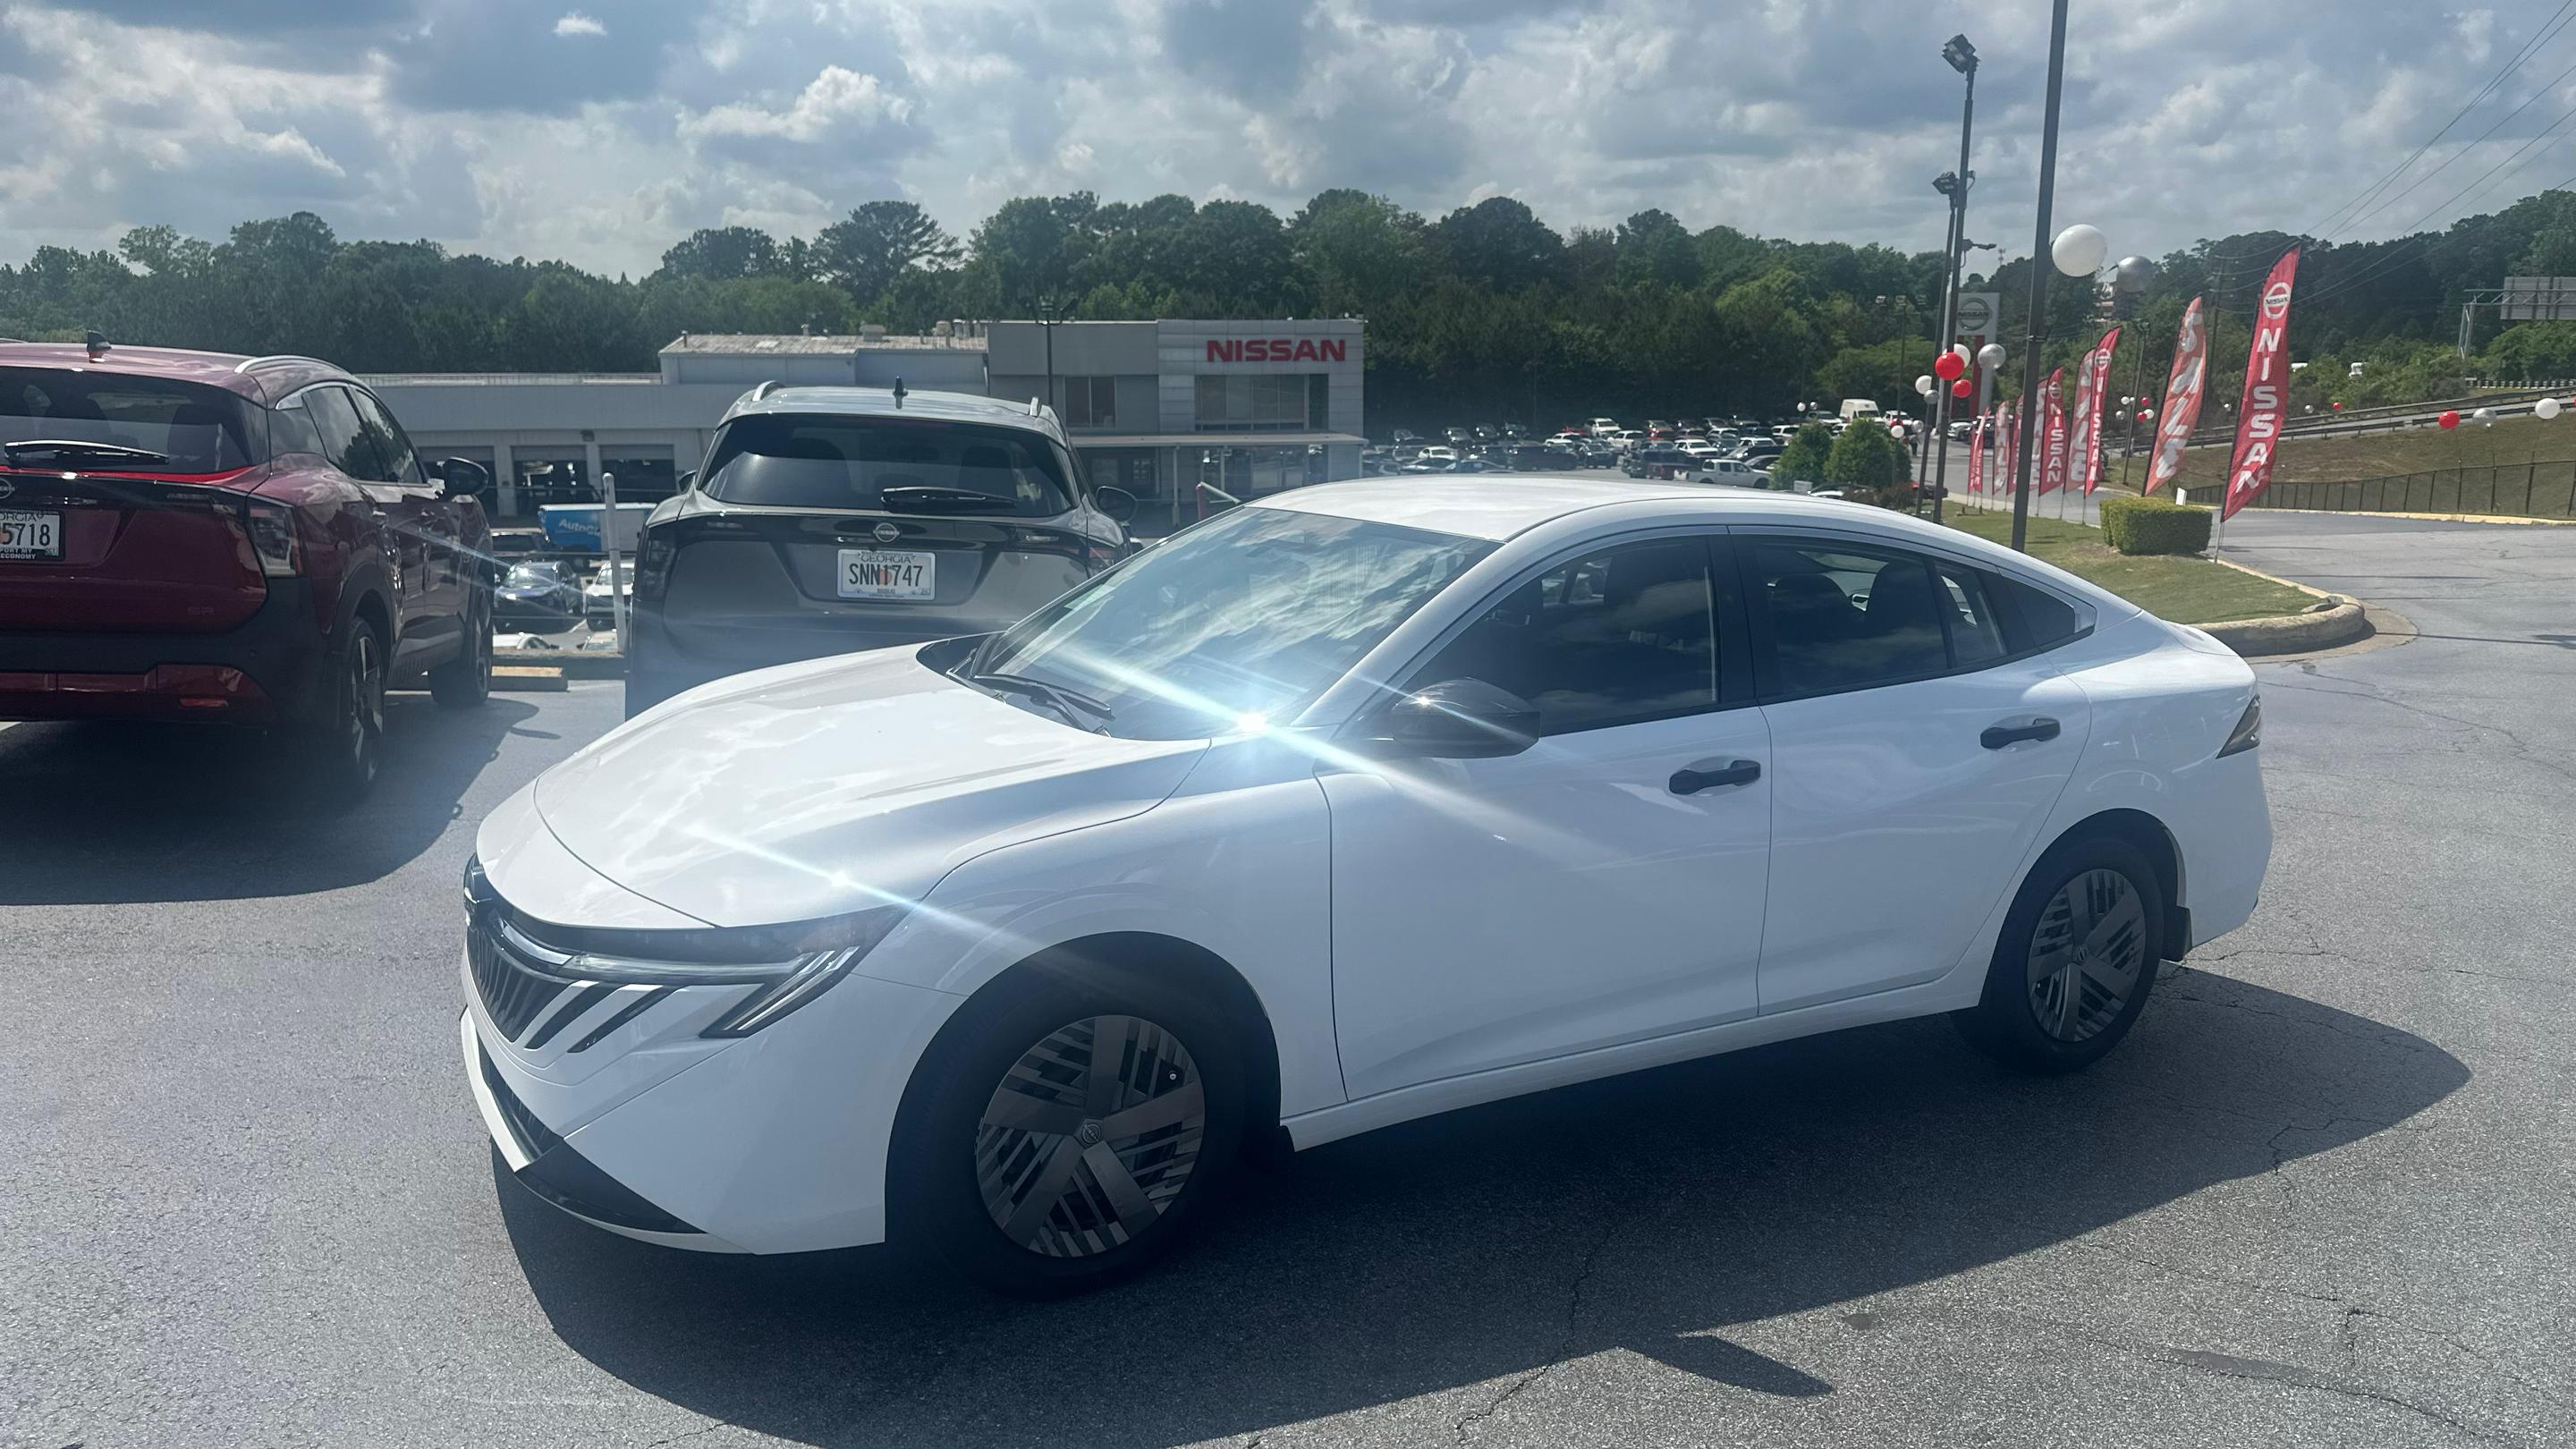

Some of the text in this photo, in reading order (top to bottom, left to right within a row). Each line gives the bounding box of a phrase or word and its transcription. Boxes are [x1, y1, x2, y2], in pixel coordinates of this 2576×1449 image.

[1207, 339, 1345, 361] NISSAN
[2236, 327, 2281, 493] NISSAN
[2046, 403, 2064, 483] NISSAN
[860, 554, 911, 564] GEORGIA
[849, 564, 923, 587] SNN1747
